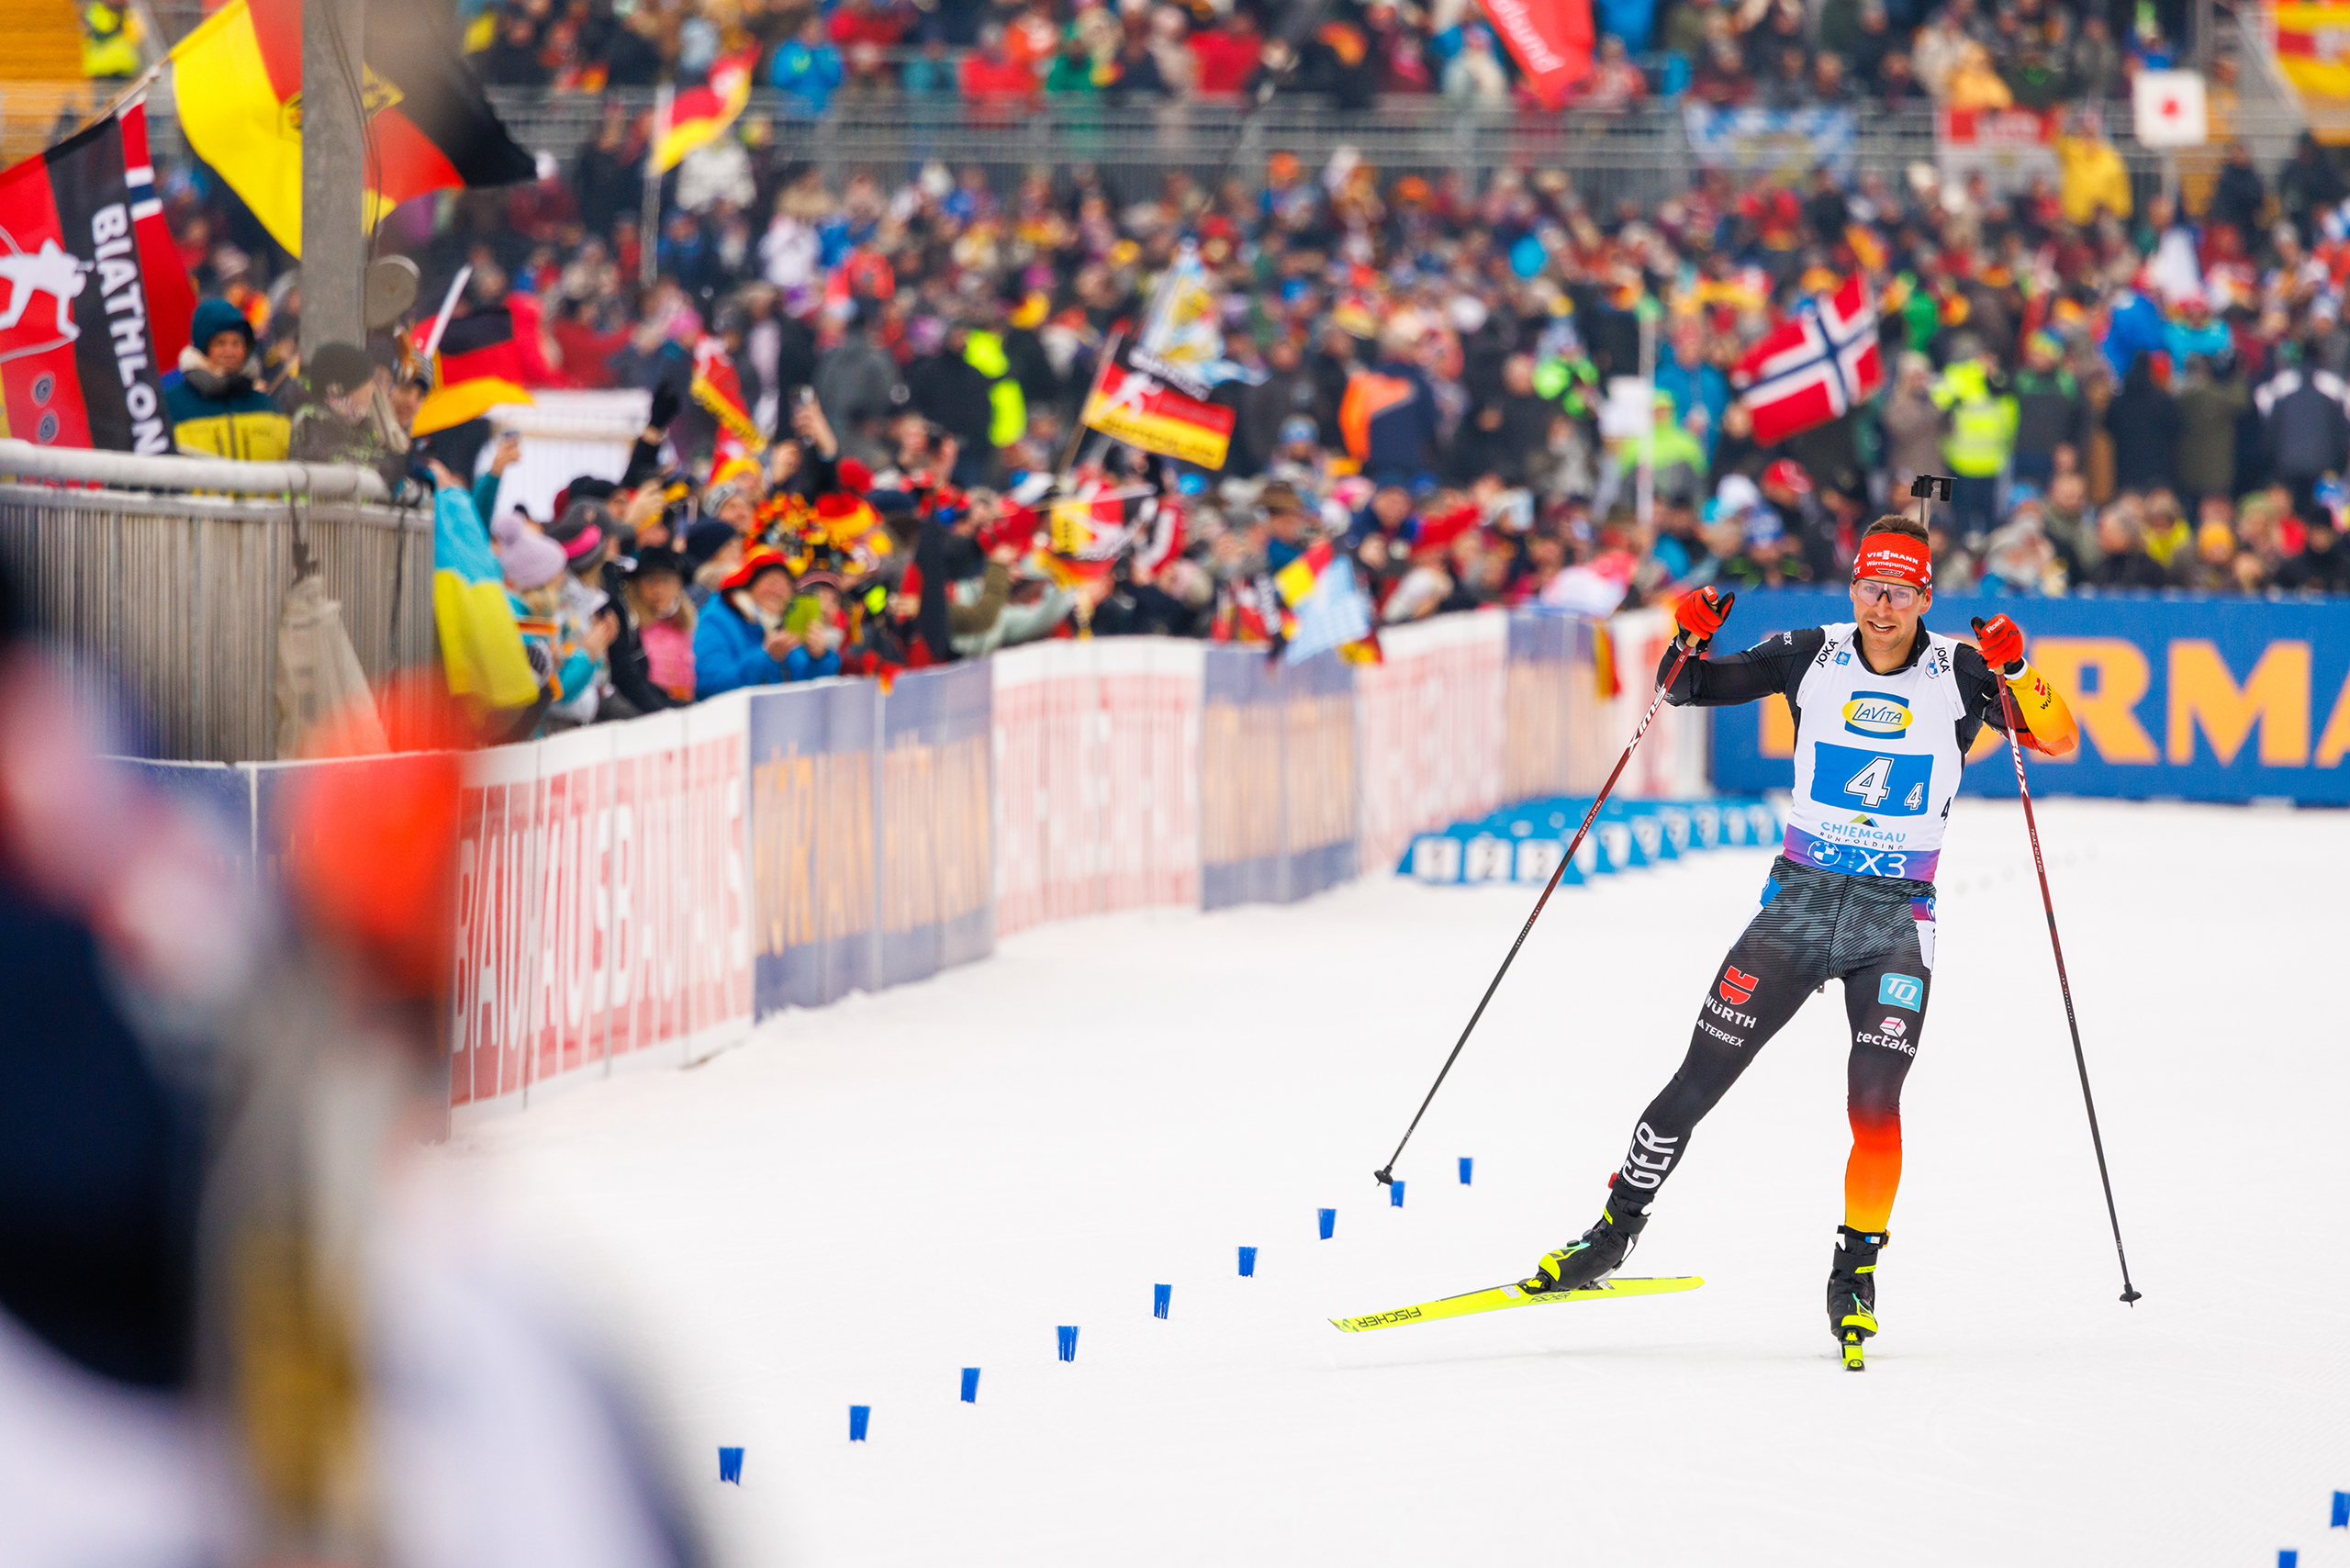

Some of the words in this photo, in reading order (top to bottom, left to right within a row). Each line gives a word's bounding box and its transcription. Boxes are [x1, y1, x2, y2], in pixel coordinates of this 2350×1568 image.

[91, 202, 170, 455] BIATHLON
[1866, 561, 1916, 573] Wärmepumpen
[1815, 638, 1839, 668] JOKA
[1934, 646, 1951, 673] JOKA
[1844, 756, 1895, 808] 4
[1904, 782, 1924, 810] 4
[1820, 821, 1906, 843] CHIEMGAU
[1855, 848, 1908, 879] X3
[1887, 978, 1918, 1006] TQ
[1705, 1022, 1745, 1047] TERREX
[1856, 1030, 1917, 1057] tectake
[1622, 1121, 1679, 1189] GER
[1355, 1306, 1422, 1327] FISCHER
